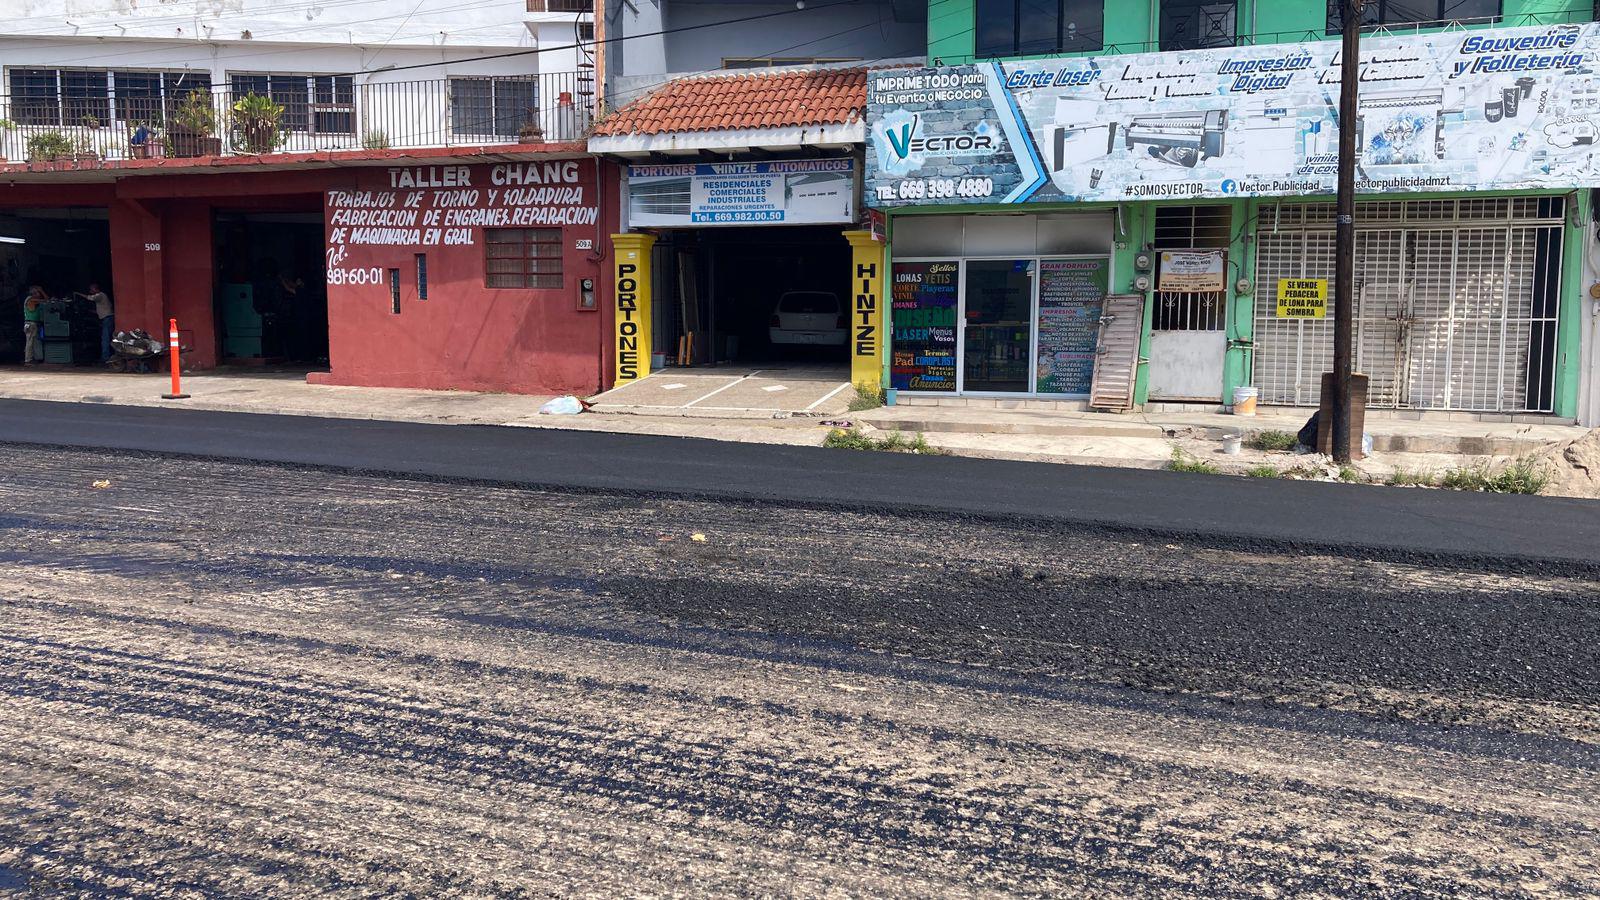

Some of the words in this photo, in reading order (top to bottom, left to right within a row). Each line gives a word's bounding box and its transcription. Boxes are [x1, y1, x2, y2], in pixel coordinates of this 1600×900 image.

[1460, 30, 1578, 54] Souvenirs
[1217, 53, 1314, 76] Impresión
[1449, 61, 1472, 79] y
[1471, 52, 1584, 75] Folletería
[876, 77, 922, 92] IMPRIME
[925, 74, 959, 90] TODO
[962, 74, 984, 89] para
[1007, 69, 1050, 88] Corte
[1230, 72, 1294, 94] Digital
[875, 94, 887, 104] tu
[887, 92, 926, 105] Evento
[934, 90, 983, 101] NEGOCIO
[388, 166, 472, 188] TALLER
[491, 161, 580, 185] CHANG
[633, 165, 697, 177] PORTONES
[717, 163, 757, 175] HINTZE
[768, 160, 850, 174] AUTOMATICOS
[1297, 165, 1315, 174] de
[703, 180, 772, 189] RESIDENCIALES
[876, 186, 897, 200] TEL:
[900, 180, 924, 199] 669
[928, 179, 954, 198] 398
[958, 178, 993, 197] 4880
[1125, 182, 1203, 196] #SOMOSVECTOR
[1239, 181, 1271, 193] Vector
[1273, 180, 1320, 192] Publicidad
[1354, 176, 1450, 191] ectorpublicidadmzt
[328, 191, 397, 208] TRABAJOS
[404, 191, 423, 208] DE
[433, 189, 480, 207] TORNO
[488, 189, 499, 207] Y
[503, 187, 583, 206] SOLDADURA
[709, 188, 766, 196] COMERCIALES
[707, 196, 767, 204] INDUSTRIALES
[331, 209, 418, 227] FABRICACION
[422, 209, 441, 226] DE
[511, 206, 598, 225] REPARACION
[695, 213, 712, 222] Tel.
[714, 212, 782, 221] 669.982.00.50
[330, 227, 347, 244] DE
[350, 228, 420, 245] MAQUINARIA
[423, 227, 440, 245] EN
[444, 228, 474, 245] GRAL
[145, 243, 160, 251] 509
[576, 240, 592, 248] 509A
[930, 264, 957, 273] Sellos
[896, 274, 922, 283] LONAS
[925, 274, 951, 283] YETIS
[1287, 281, 1296, 289] SE
[1297, 281, 1318, 289] VENDE
[920, 285, 955, 294] Playeras
[1285, 290, 1319, 298] PEDACERA
[857, 263, 876, 356] HINTZE
[1279, 299, 1289, 307] DE
[1289, 299, 1305, 307] LONA
[1306, 299, 1324, 307] PARA
[1286, 308, 1315, 316] SOMBRA
[618, 264, 637, 379] PORTONES
[896, 329, 929, 341] LASER
[895, 357, 915, 366] Pad
[915, 356, 956, 366] COROPLAST
